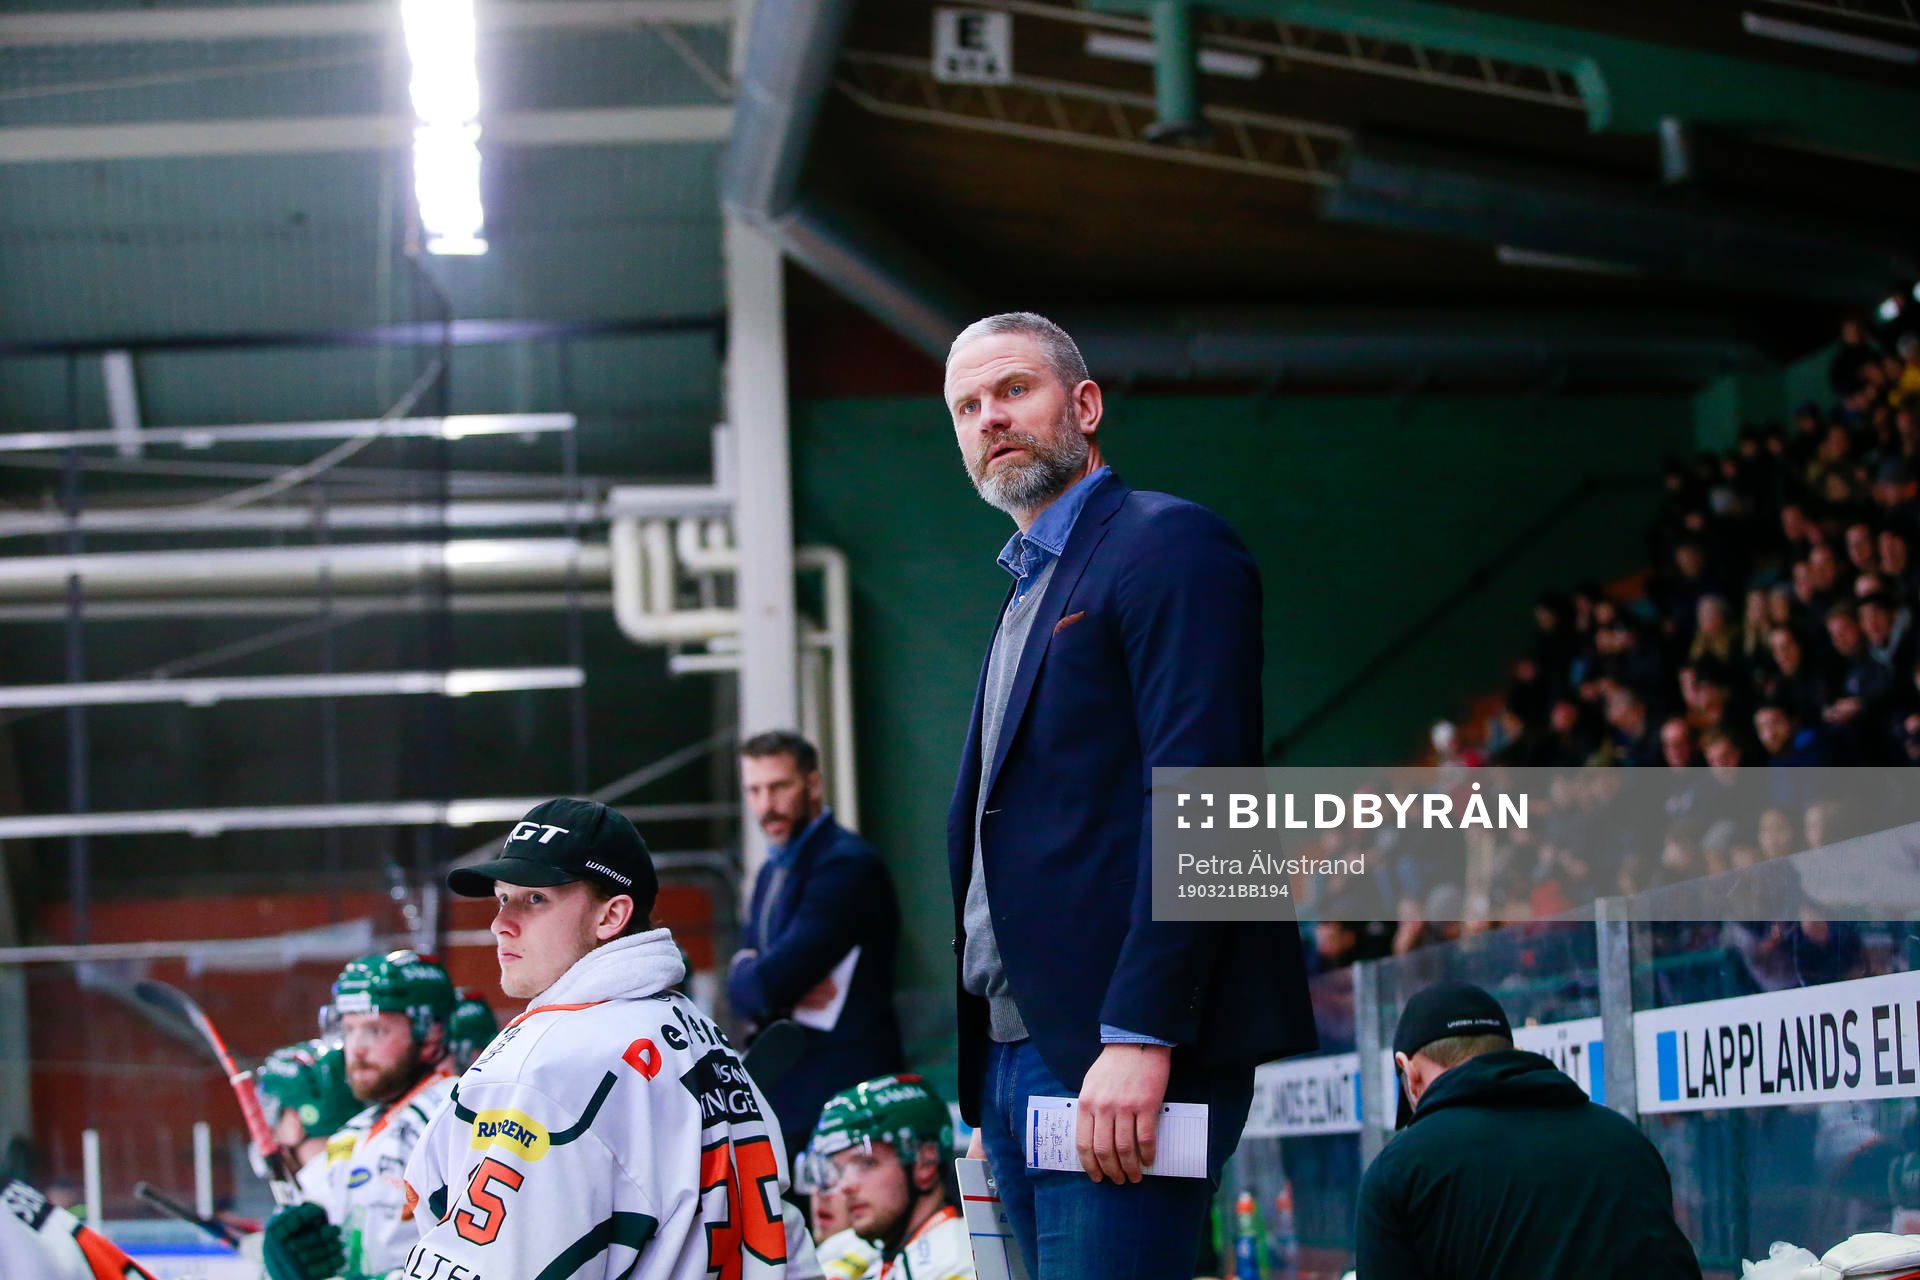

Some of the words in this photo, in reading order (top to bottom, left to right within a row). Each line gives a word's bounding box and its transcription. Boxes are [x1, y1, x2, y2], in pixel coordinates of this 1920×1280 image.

[503, 821, 570, 849] GT
[585, 859, 633, 887] WARRIOR
[1683, 1009, 1861, 1099] LAPPLANDS
